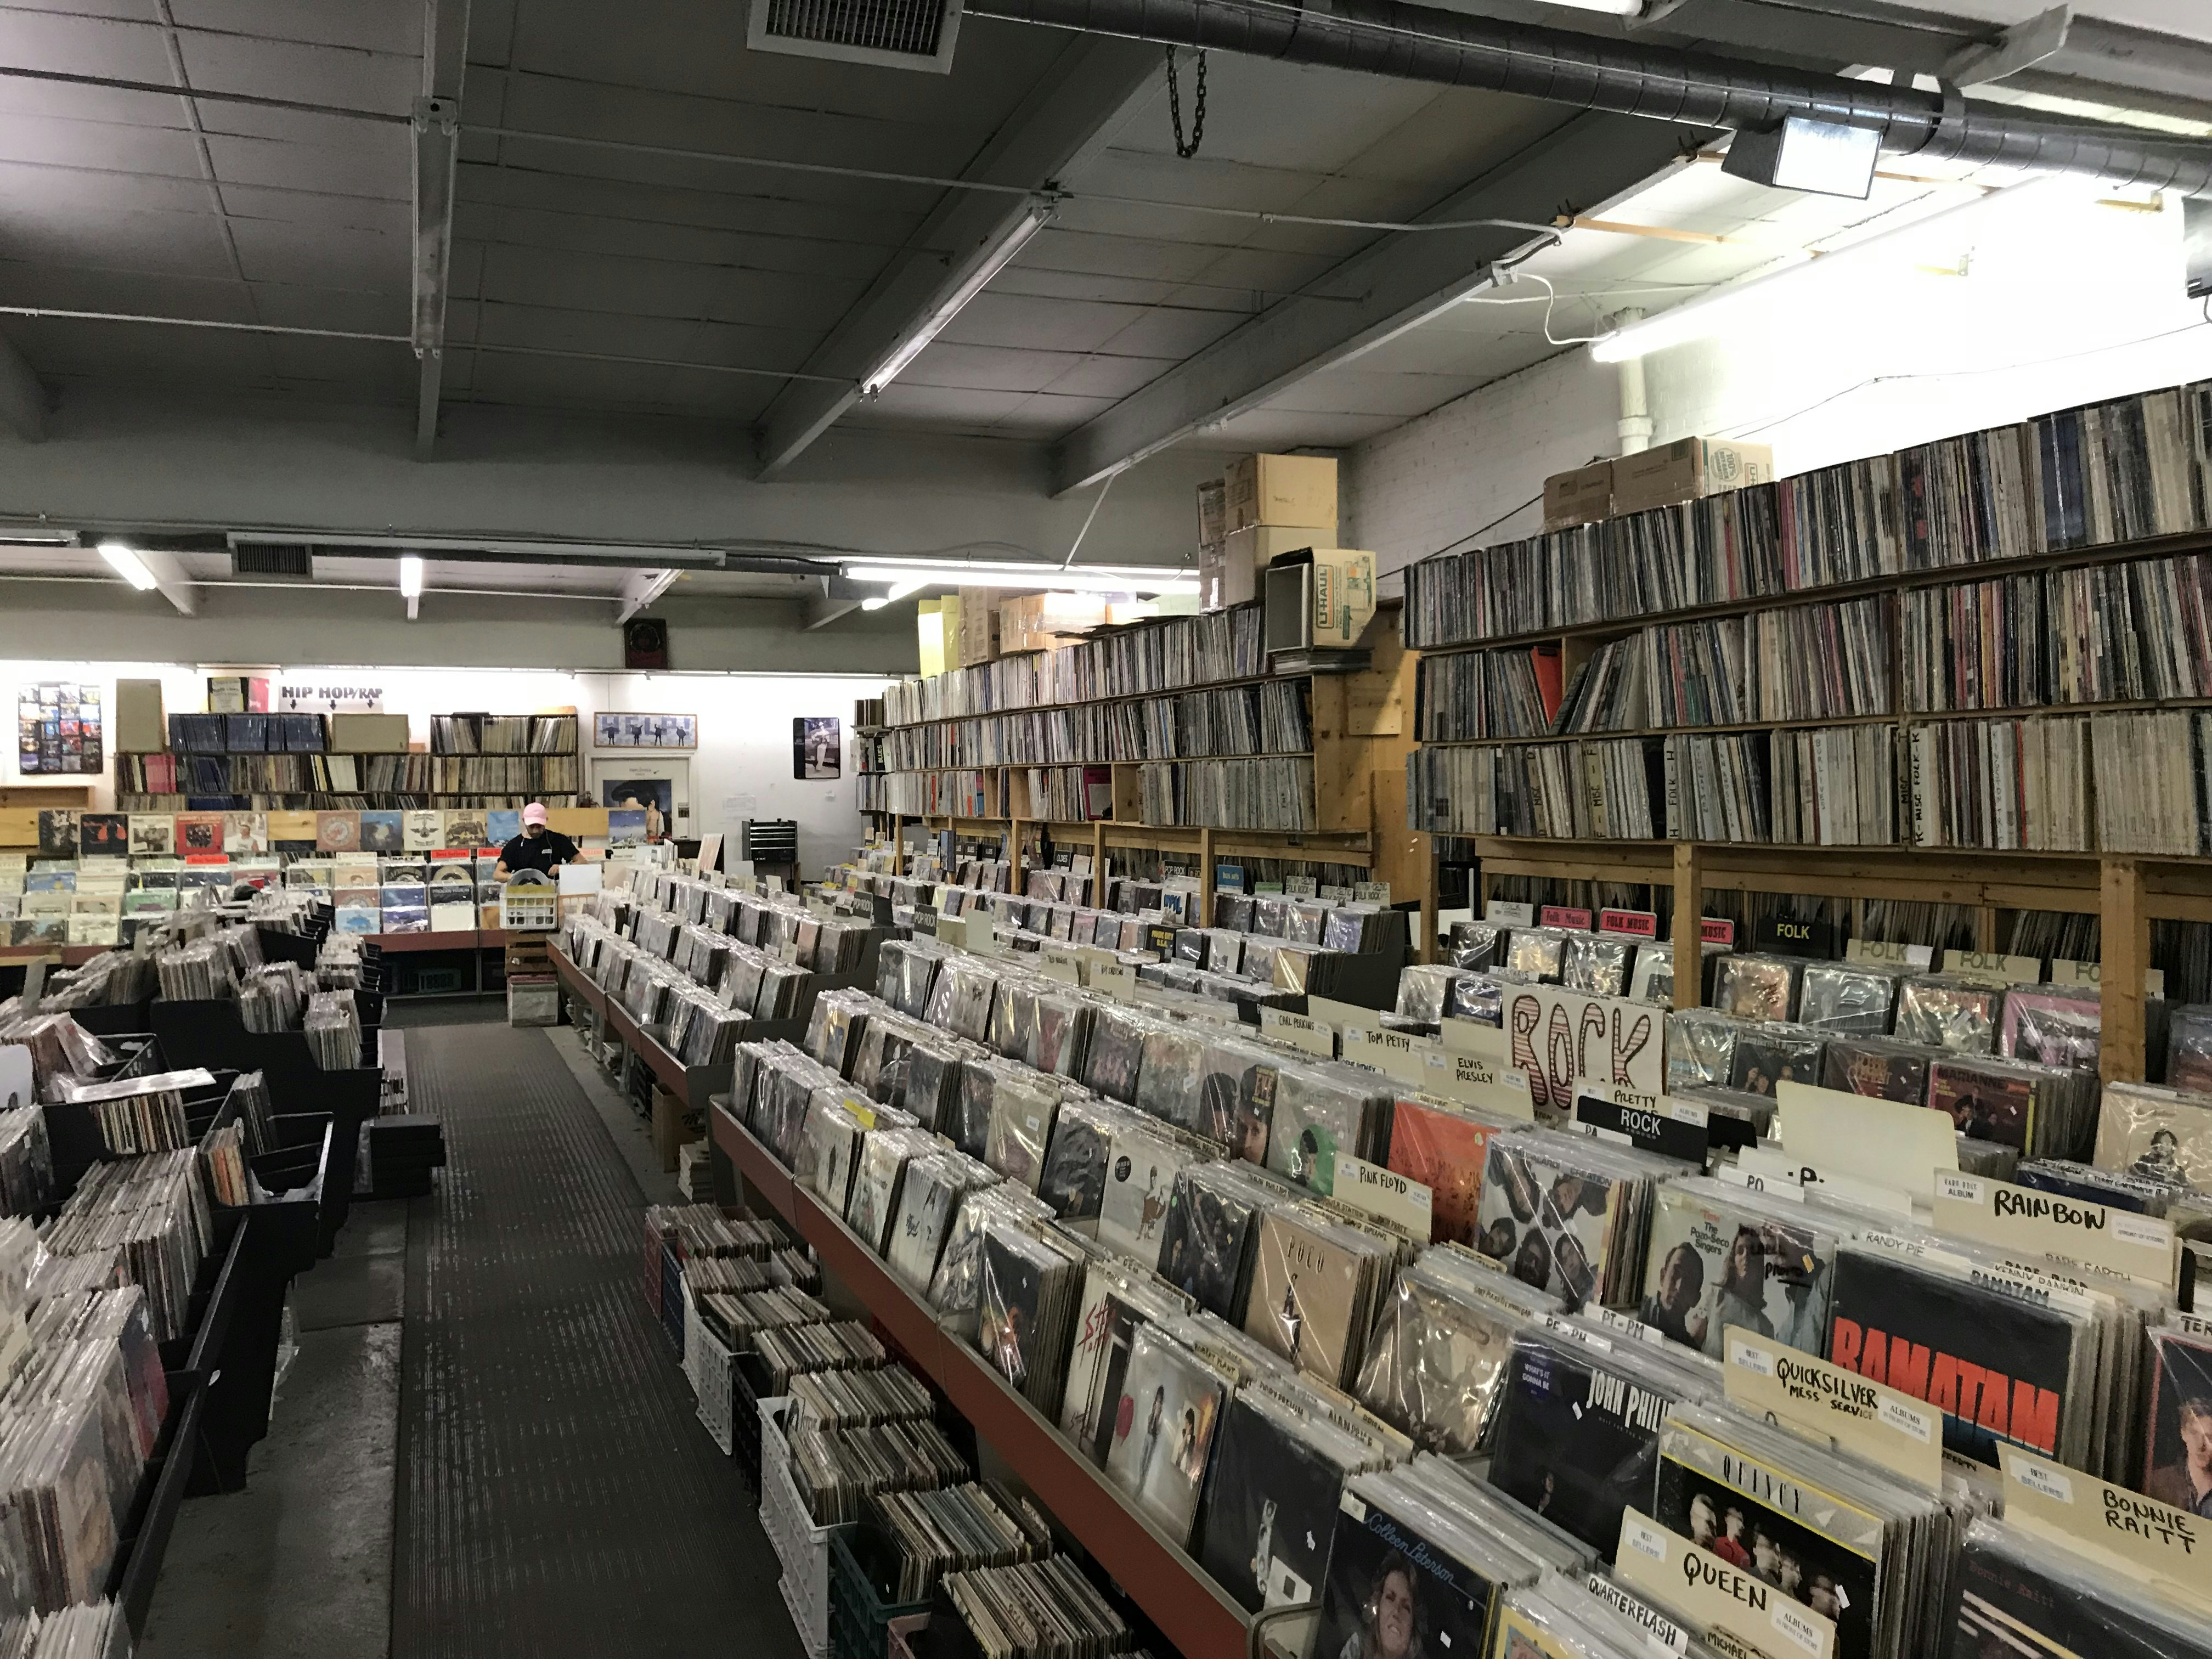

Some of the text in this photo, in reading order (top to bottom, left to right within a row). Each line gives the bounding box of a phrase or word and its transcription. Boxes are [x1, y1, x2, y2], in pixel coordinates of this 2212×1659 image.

[1319, 569, 1328, 624] U-HAUL
[282, 686, 383, 699] HIP HOP/RAP
[601, 715, 691, 736] HELP!
[1593, 785, 1603, 807] MISC
[1668, 778, 1678, 806] FOLK
[1545, 911, 1585, 925] Folk Music
[1605, 915, 1650, 931] FOLK MUSIC
[1776, 923, 1810, 939] FOLK
[1860, 940, 1908, 962] FOLK
[1960, 950, 2007, 972] FOLK
[1279, 1015, 1315, 1031] CARL PERKINS
[1365, 1030, 1410, 1052] TOM PETTY
[1511, 994, 1652, 1110] ROCK
[1458, 1057, 1483, 1070] ELVIS
[1456, 1069, 1493, 1085] PRESLEY
[1614, 1089, 1656, 1108] PRETTY
[1621, 1108, 1661, 1136] ROCK
[1380, 1173, 1407, 1194] FLOYD
[1948, 1189, 1974, 1200] ALBUM
[1994, 1189, 2106, 1230] RAINBOW
[1690, 1226, 1729, 1249] Pozo-Seco
[1704, 1221, 1718, 1234] The
[1287, 1234, 1324, 1274] POCO
[1695, 1239, 1723, 1256] Singers
[1866, 1231, 1925, 1257] RANDY PIE
[1625, 1318, 1645, 1340] PM
[1586, 1369, 1626, 1415] JOHN
[1776, 1357, 1879, 1409] QUICKSILVER
[1830, 1399, 1874, 1420] SERVICE
[1889, 1404, 1921, 1426] ALBUMS
[2103, 1488, 2194, 1536] BONNIE
[2105, 1510, 2196, 1555] RAITT
[1363, 1513, 1455, 1584] Colleen Peterson
[1683, 1552, 1767, 1611] QUEEN
[1588, 1577, 1677, 1646] QUARTERFLASH
[1783, 1612, 1814, 1639] ALBUMS
[1707, 1632, 1748, 1659] MICHAEL
